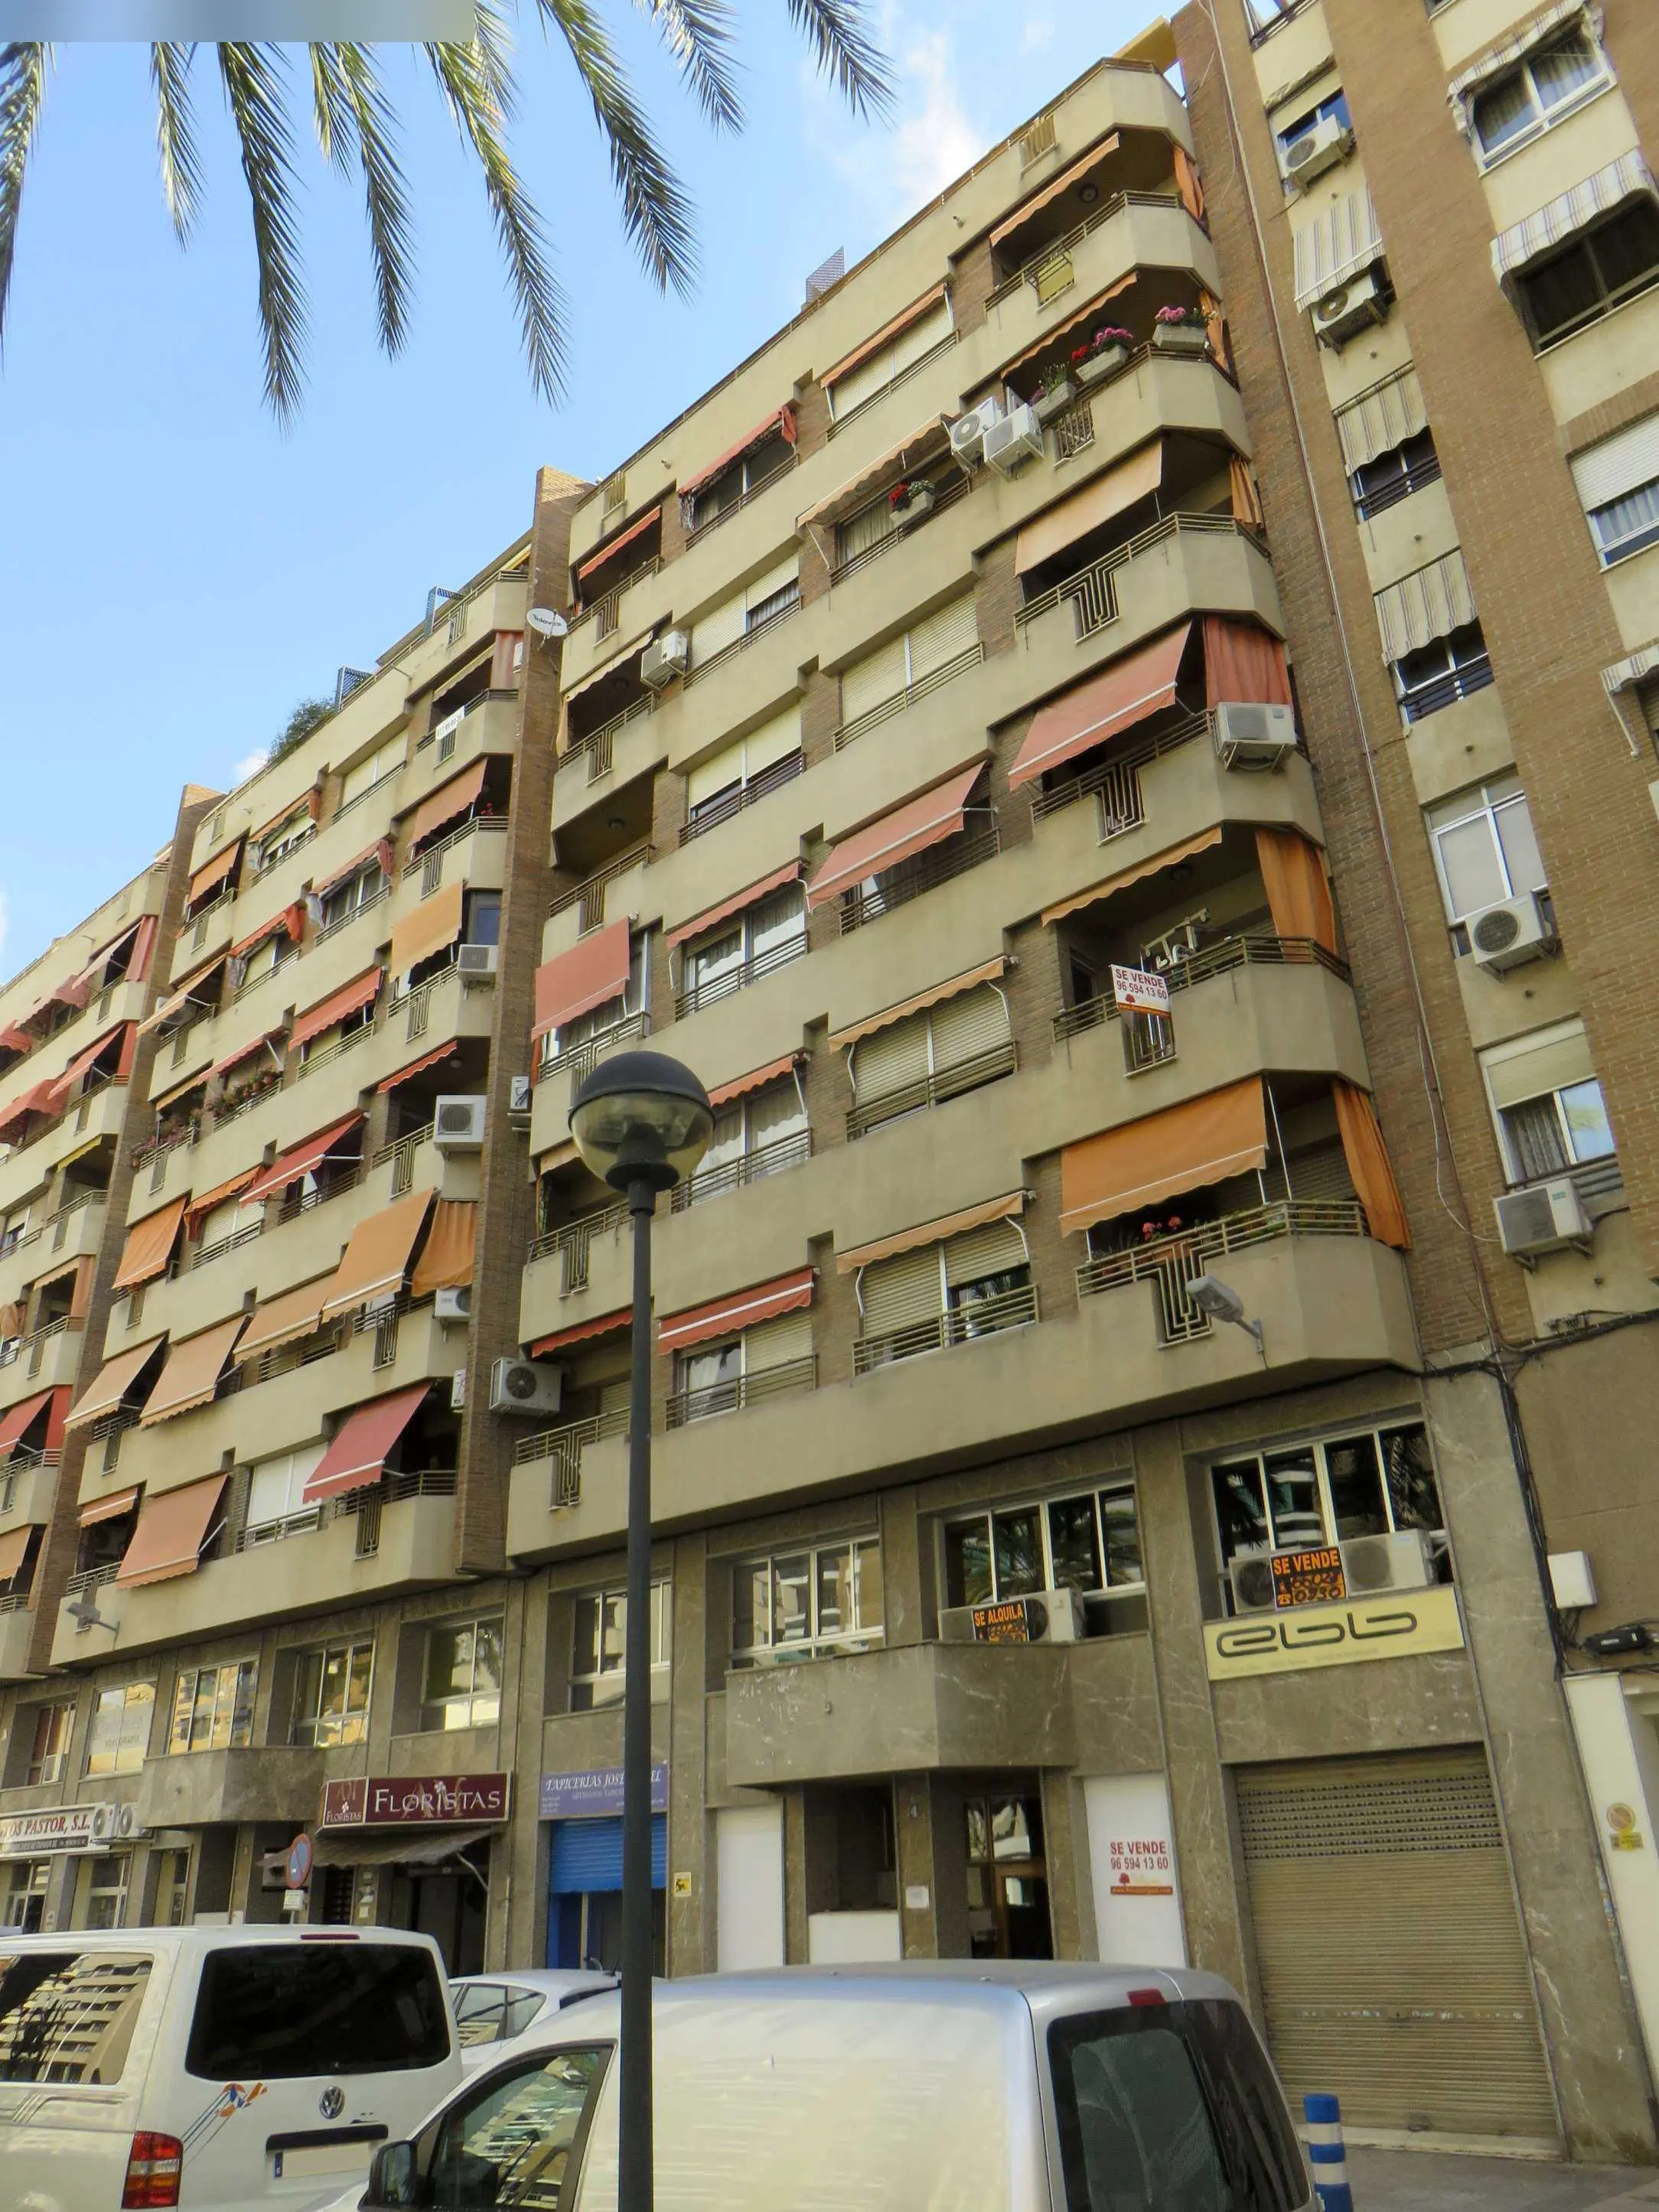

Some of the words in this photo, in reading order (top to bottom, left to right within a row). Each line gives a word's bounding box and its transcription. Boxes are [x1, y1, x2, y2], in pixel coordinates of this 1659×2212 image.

[1115, 969, 1128, 980] SE
[1131, 973, 1164, 988] VENDE
[1116, 980, 1127, 992] 96
[1129, 983, 1144, 994] 594
[1146, 987, 1156, 997] 13
[1157, 989, 1167, 999] 60
[1273, 1557, 1291, 1575] SE
[1292, 1549, 1341, 1572] VENDE
[974, 1611, 986, 1627] SE
[988, 1603, 1023, 1624] ALQUILA
[374, 1788, 500, 1813] FLORISTAS
[25, 1816, 67, 1836] PASTOR,
[71, 1813, 90, 1831] S.L.
[326, 1810, 363, 1823] FLORISTAS
[1110, 1842, 1124, 1855] SE
[1126, 1840, 1167, 1855] VENDE
[1110, 1857, 1122, 1870] 96
[1123, 1857, 1141, 1870] 594
[1143, 1857, 1155, 1870] 13
[1157, 1856, 1169, 1870] 60
